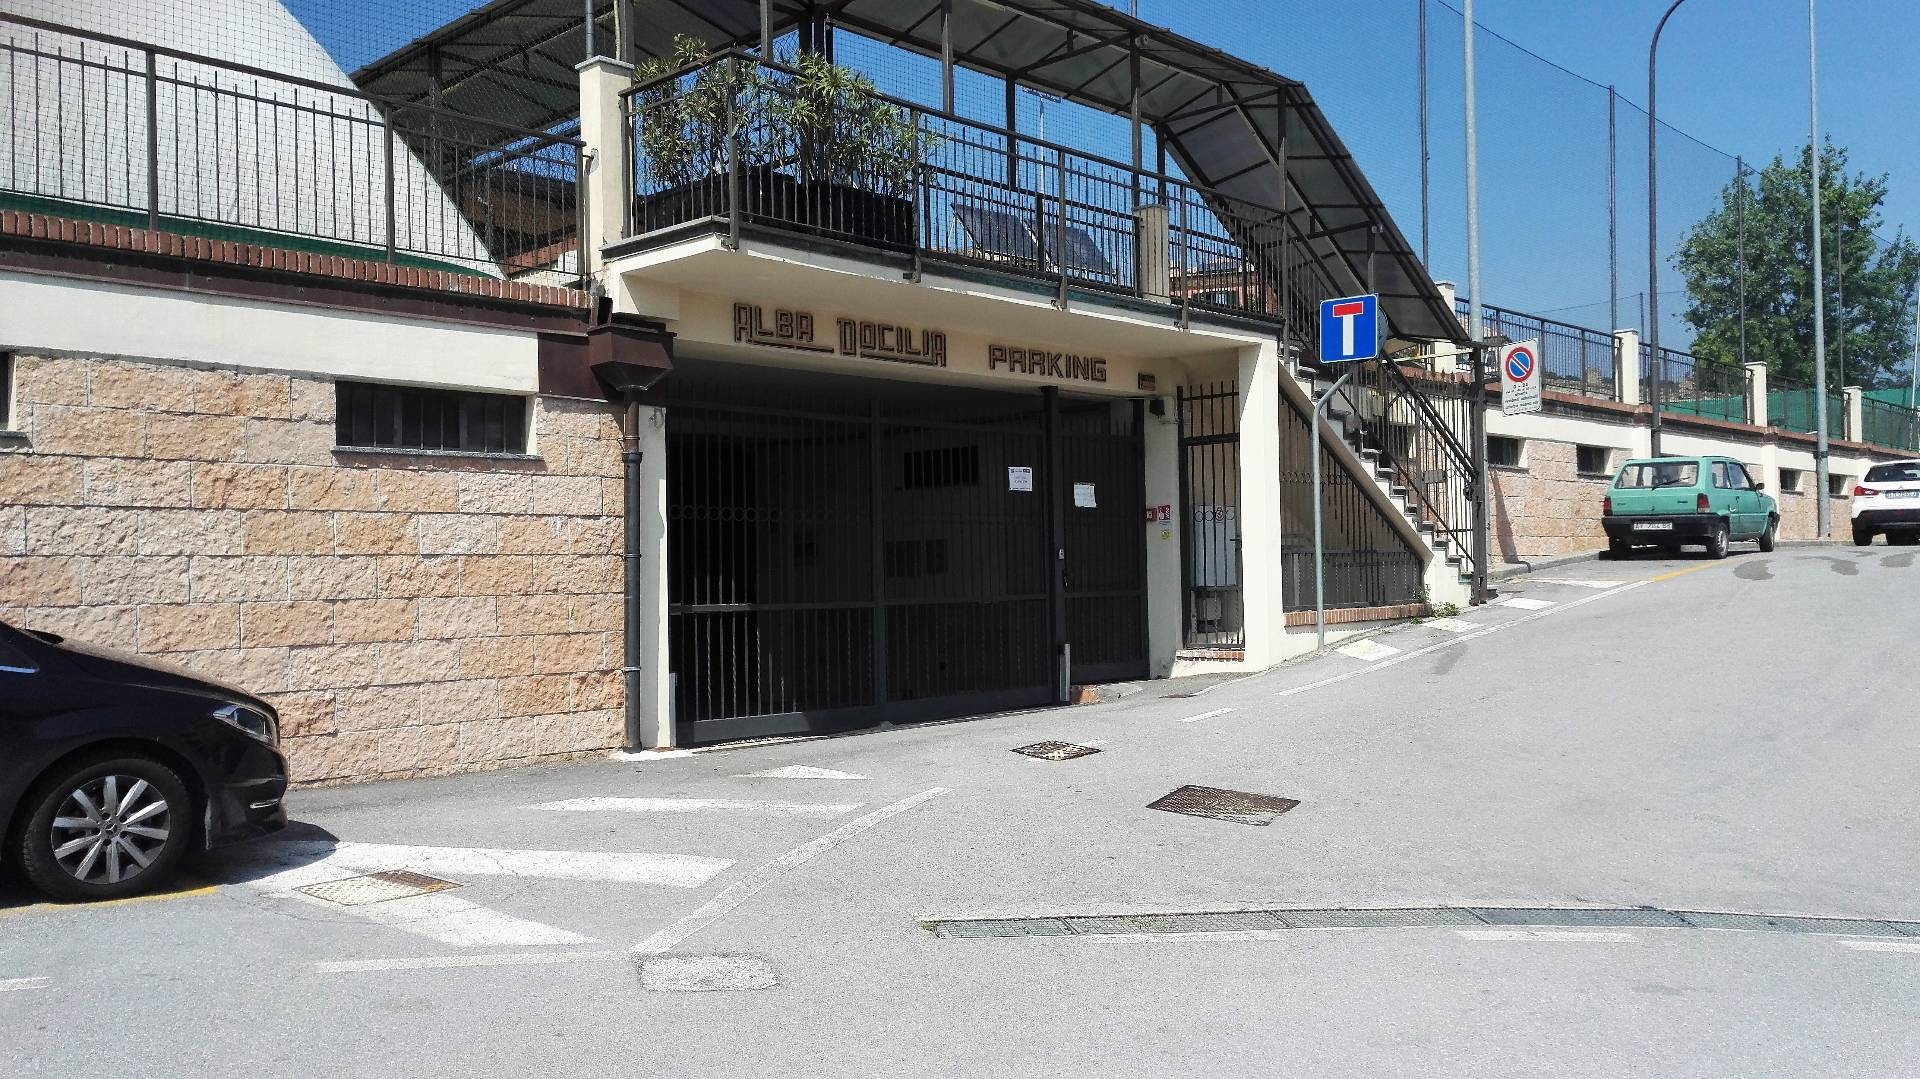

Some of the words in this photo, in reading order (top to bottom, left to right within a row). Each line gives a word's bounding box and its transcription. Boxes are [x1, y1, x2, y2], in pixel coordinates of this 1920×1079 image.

[733, 301, 816, 345] ALBA
[836, 316, 947, 369] DOCILIA
[988, 343, 1107, 383] PARKING
